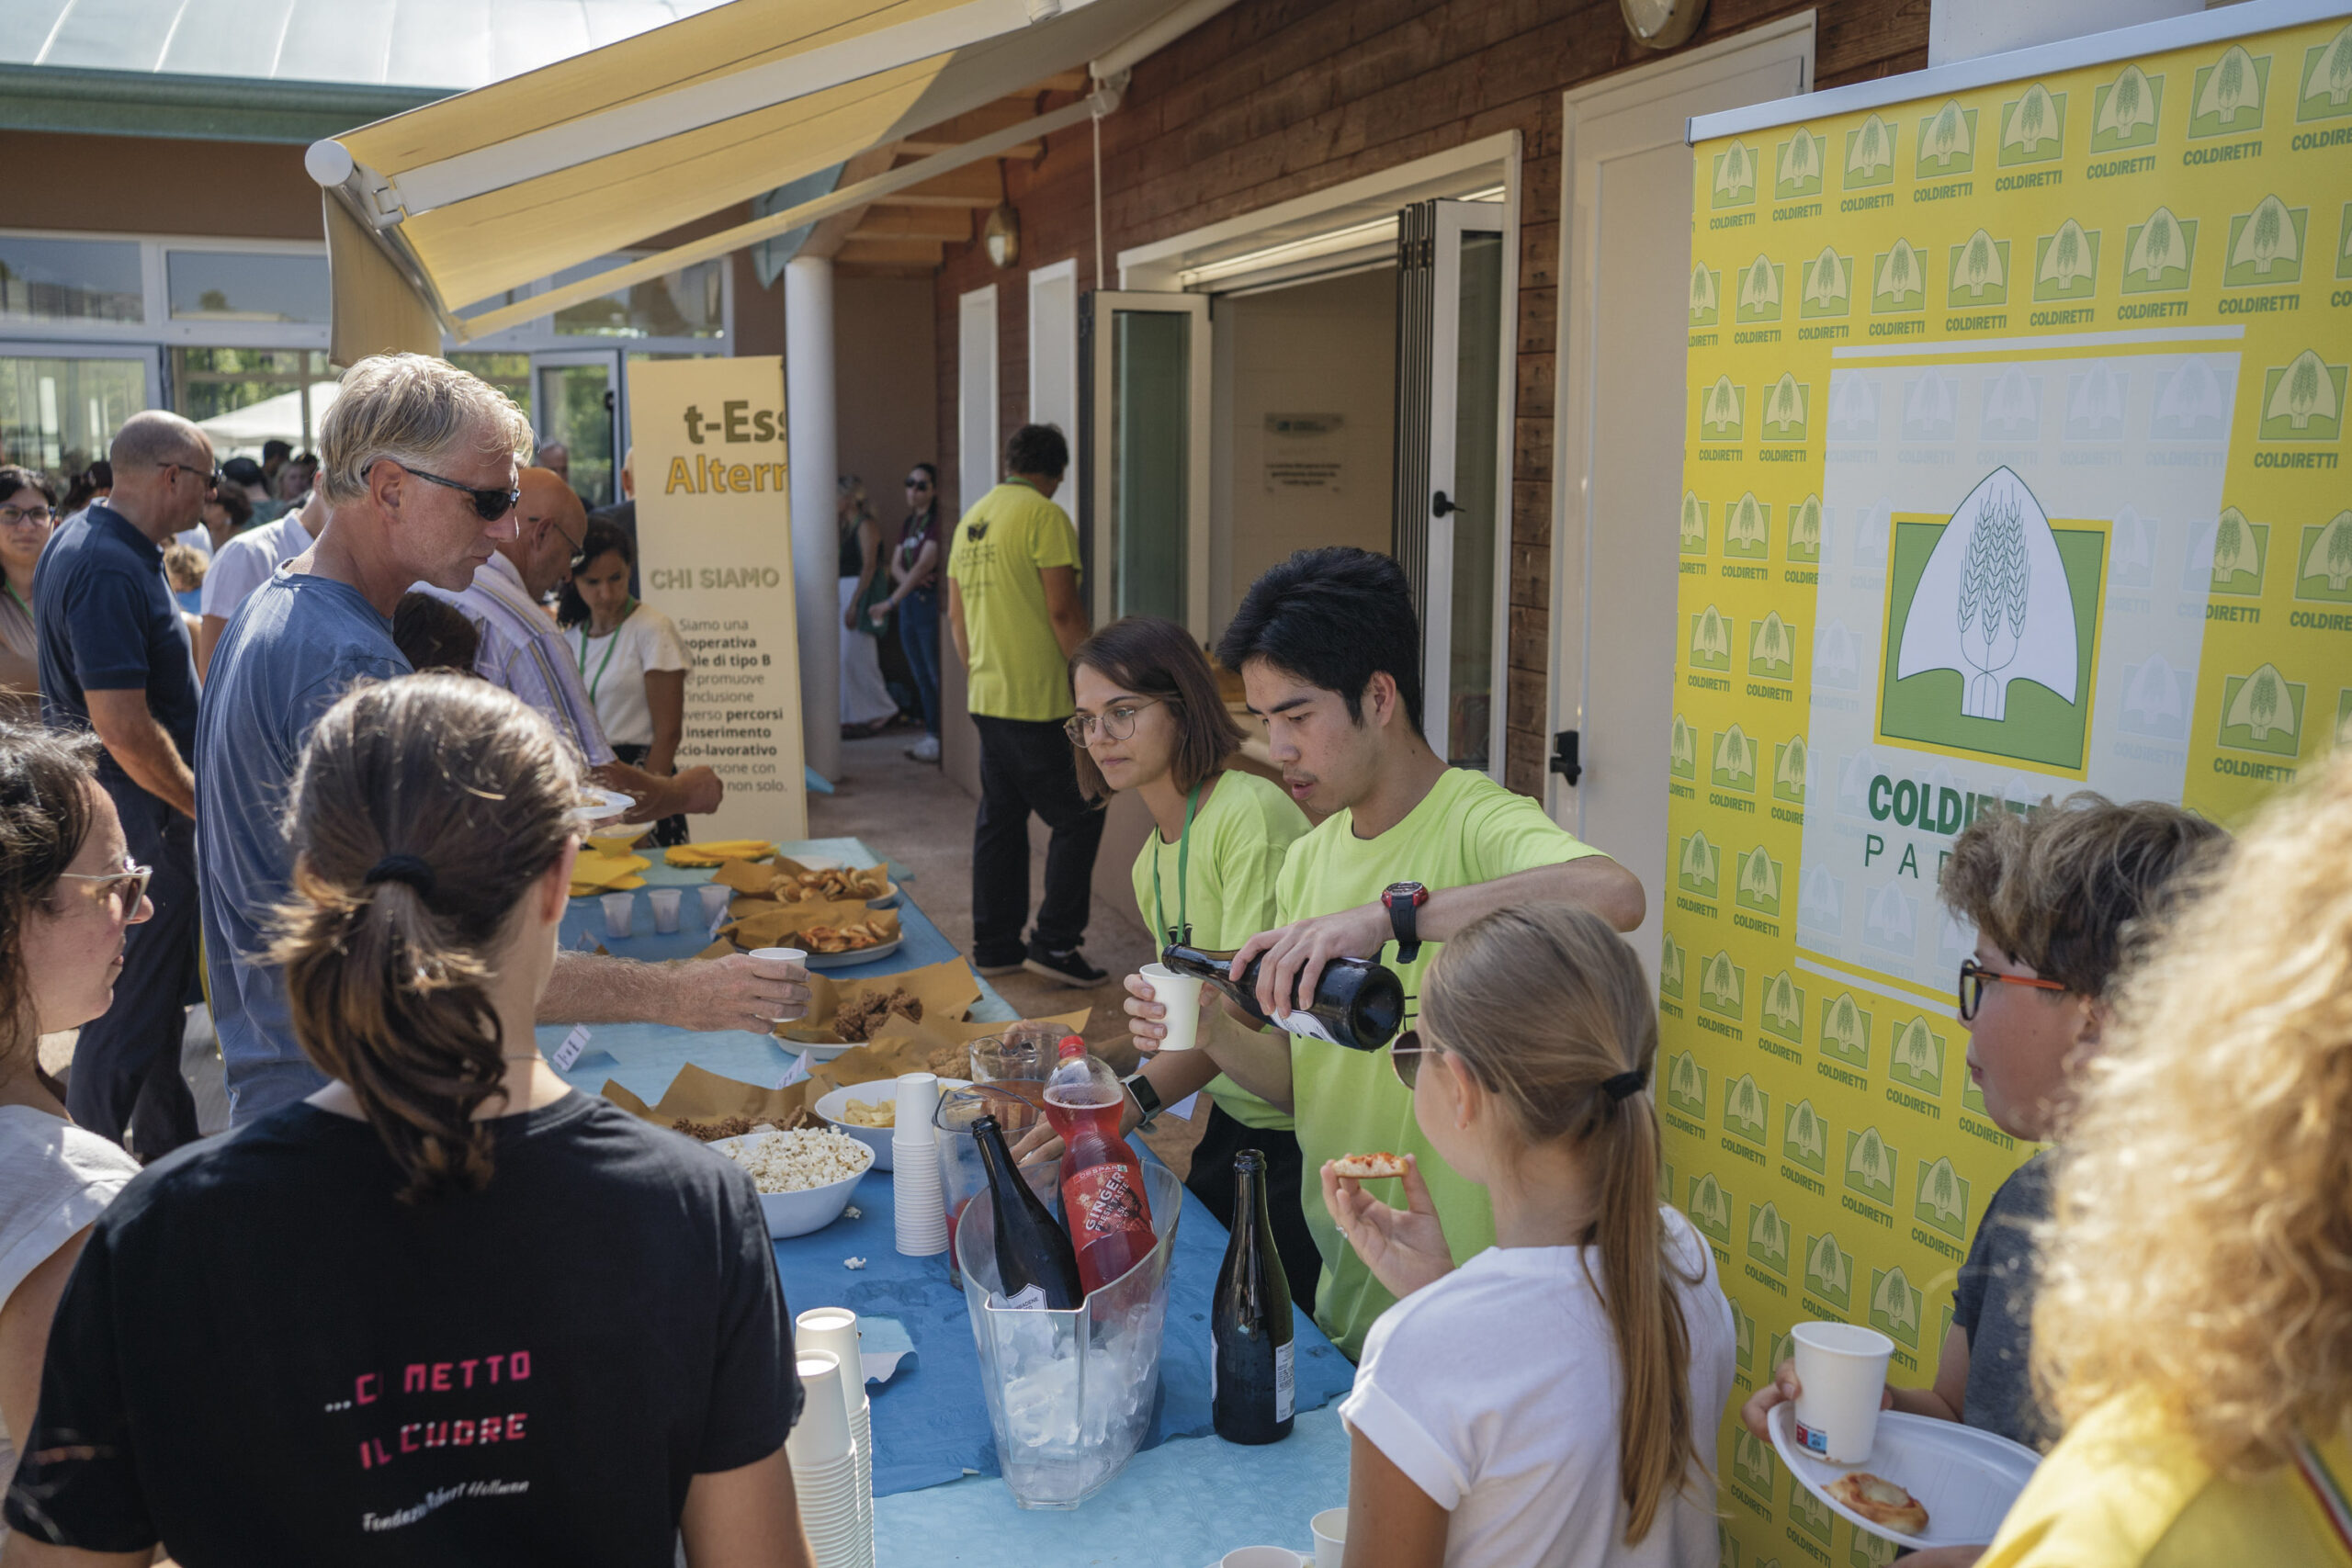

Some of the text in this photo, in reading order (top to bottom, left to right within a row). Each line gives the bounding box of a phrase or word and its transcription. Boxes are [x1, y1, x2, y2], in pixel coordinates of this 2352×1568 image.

[2183, 141, 2262, 165] COLDIRETTI
[2086, 155, 2155, 179] COLDIRETTI
[1996, 170, 2063, 191] COLDIRETTI
[1914, 182, 1973, 202] COLDIRETTI
[1772, 203, 1822, 221] COLDIRETTI
[1840, 193, 1894, 212] COLDIRETTI
[1710, 212, 1756, 230] COLDIRETTI
[2118, 301, 2188, 320] COLDIRETTI
[2218, 294, 2300, 314] COLDIRETTI
[1946, 314, 2007, 332] COLDIRETTI
[2030, 309, 2095, 326] COLDIRETTI
[1735, 330, 1781, 344] COLDIRETTI
[1798, 325, 1849, 340] COLDIRETTI
[1869, 320, 1925, 336] COLDIRETTI
[1699, 449, 1743, 461] COLDIRETTI
[1759, 449, 1806, 462] COLDIRETTI
[2254, 452, 2339, 468] COLDIRETTI
[650, 567, 780, 590] CHI SIAMO
[1722, 565, 1768, 581] COLDIRETTI
[679, 618, 749, 632] Siamo una
[713, 653, 726, 667] di
[729, 653, 758, 670] tipo
[762, 654, 772, 666] B
[696, 673, 765, 687] promuove
[1688, 674, 1730, 693] COLDIRETTI
[1747, 683, 1792, 702] COLDIRETTI
[726, 707, 784, 724] percorsi
[686, 726, 772, 739] inserimento
[674, 743, 777, 757] ocio-lavorativo
[752, 762, 776, 774] con
[727, 781, 753, 793] non
[1709, 793, 1756, 814] COLDIRETTI
[1677, 897, 1718, 919] COLDIRETTI
[1734, 913, 1780, 938] COLDIRETTI
[1697, 1015, 1743, 1042] COLDIRETTI
[1758, 1037, 1802, 1066] COLDIRETTI
[1817, 1062, 1868, 1091] COLDIRETTI
[1886, 1088, 1940, 1120] COLDIRETTI
[1666, 1111, 1705, 1140] COLDIRETTI
[1959, 1116, 2014, 1151] COLDIRETTI
[1721, 1137, 1766, 1167] COLDIRETTI
[1781, 1165, 1825, 1197] COLDIRETTI
[1085, 1171, 1125, 1231] GINGER
[1094, 1181, 1129, 1232] FRESH TASTE
[1841, 1195, 1893, 1229] COLDIRETTI
[1911, 1227, 1964, 1265] COLDIRETTI
[1745, 1264, 1787, 1298] COLDIRETTI
[404, 1350, 531, 1393] METTO
[359, 1413, 528, 1471] IL CUORE
[1731, 1484, 1772, 1524] COLDIRETTI
[1786, 1527, 1831, 1568] COLDIRETTI
